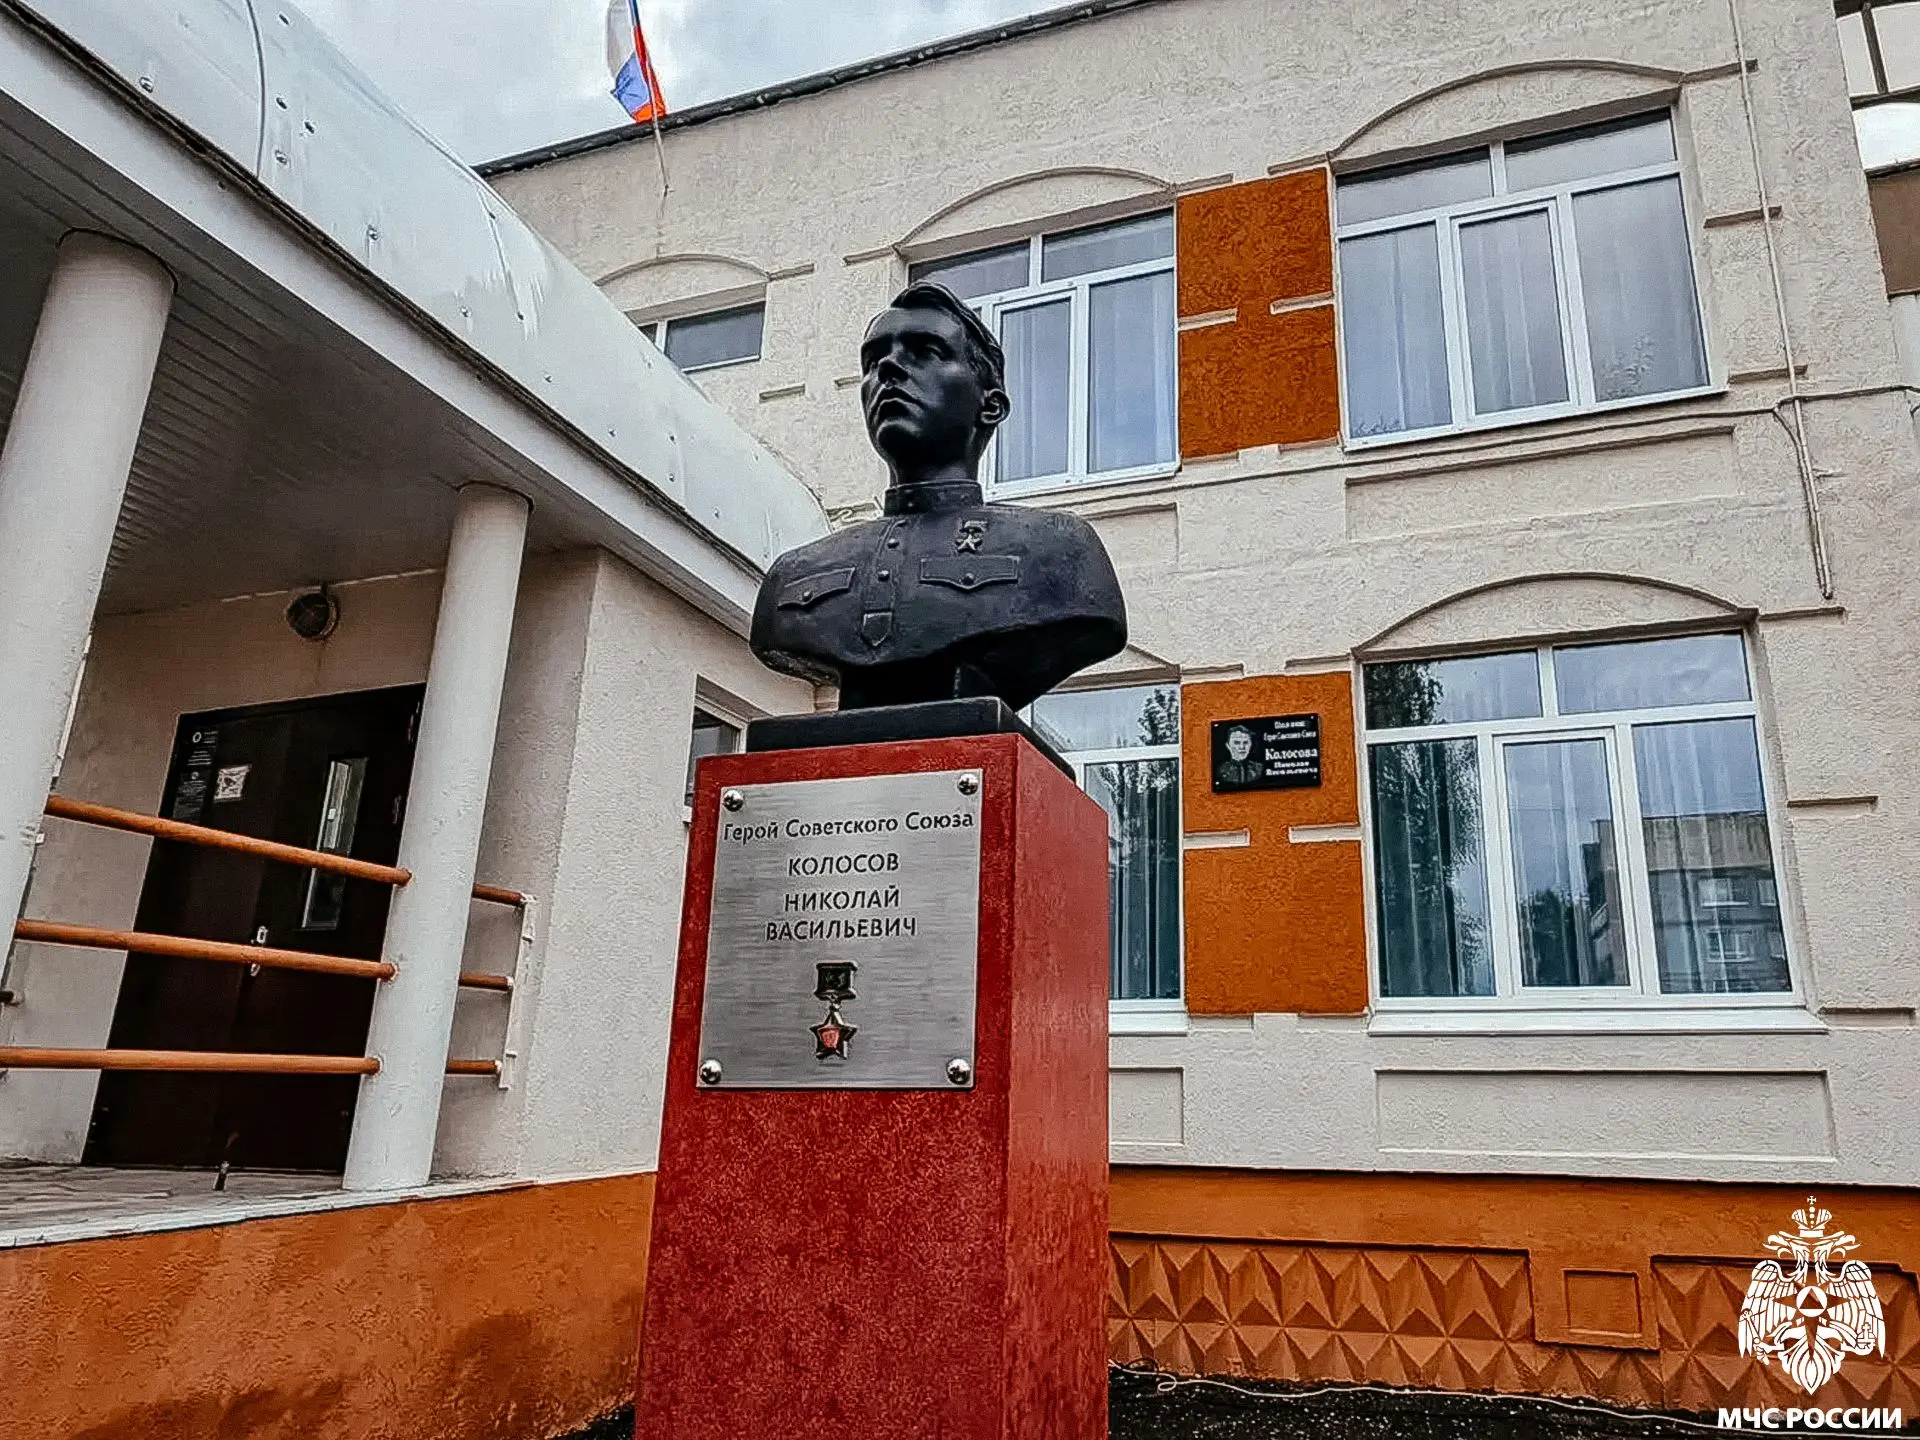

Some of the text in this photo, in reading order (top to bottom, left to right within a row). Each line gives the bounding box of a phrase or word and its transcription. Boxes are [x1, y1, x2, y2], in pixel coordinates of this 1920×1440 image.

[723, 810, 974, 844] Герой Советского Союза
[788, 853, 899, 876] КОЛОСОВ
[784, 885, 900, 912] НИКОЛАЙ
[765, 917, 917, 941] ВАСИЛЬЕВИЧ
